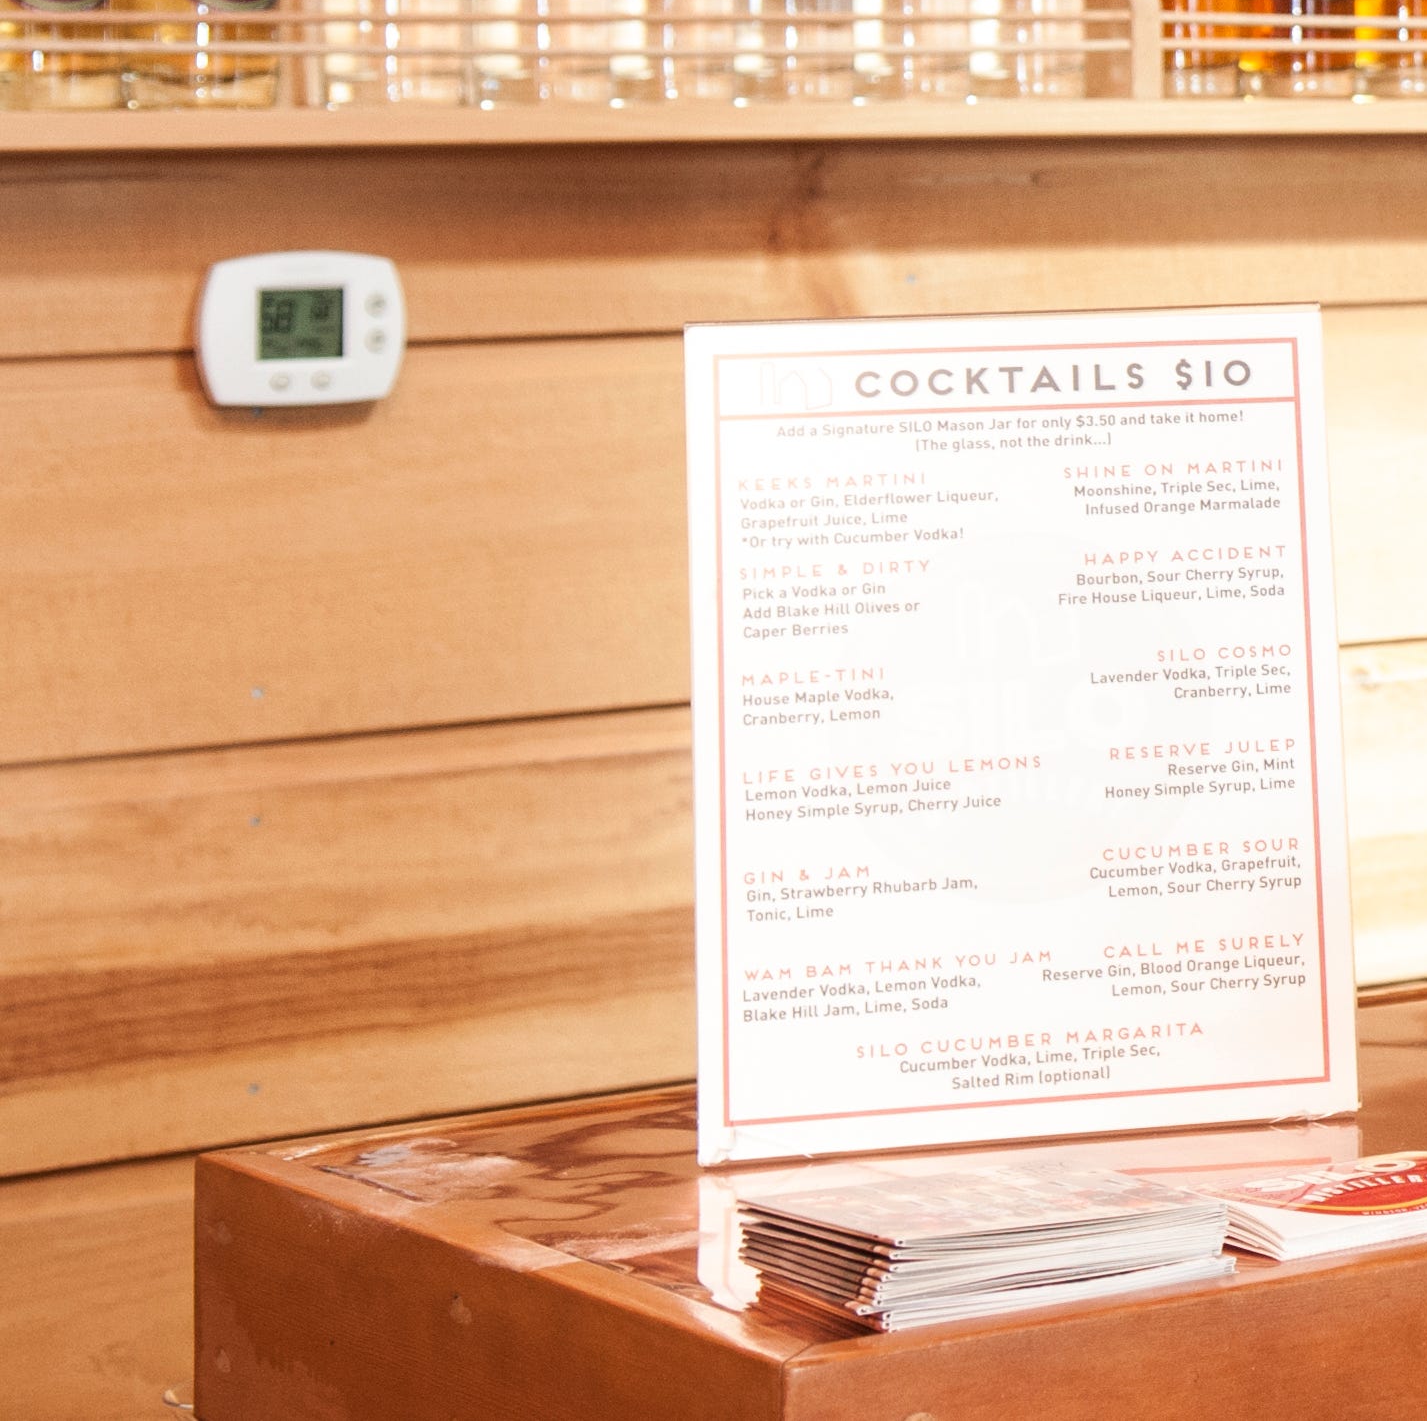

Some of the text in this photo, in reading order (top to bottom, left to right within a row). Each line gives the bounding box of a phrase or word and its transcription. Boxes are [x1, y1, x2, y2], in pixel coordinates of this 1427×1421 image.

[855, 358, 1251, 398] COCKTAILS $10
[777, 410, 1243, 438] Add a Signature SILO Mason Jar for only $3.50 and take it home!
[1063, 459, 1281, 479] SHINE ON MARTINI
[1074, 479, 1280, 497] Moonshine, Triple Sec, Lime,
[1085, 497, 1280, 515] Infused Orange Marmalade
[1084, 545, 1285, 566] HAPPY ACCIDENT
[1076, 567, 1284, 586] Bourbon, Sour Cherry Syrup,
[1058, 584, 1285, 605] Fire House Liqueur, Lime, Soda
[1157, 644, 1291, 662] SILO COSMO
[742, 667, 884, 687] MAPLE-TINI
[743, 688, 894, 706] House Maple Vodka,
[1174, 683, 1291, 699] Cranberry, Lime
[743, 709, 880, 726] Cranberry, Lemon
[1109, 738, 1295, 760] RESERVE JULEP
[742, 755, 1041, 785] LIFE GIVES YOU LEMONS
[1168, 758, 1294, 776] Reserve Gin, Mint
[745, 779, 951, 802] Lemon Vodka, Lemon Juice
[1105, 778, 1295, 799] Honey Simple Syrup, Lime
[746, 795, 1001, 822] Honey Simple Syrup, Cherry Juice
[1102, 837, 1298, 862] CUCUMBER SOUR
[744, 866, 869, 885] GIN & JAM
[1090, 855, 1301, 879] Cucumber Vodka, Grapefruit,
[746, 877, 978, 903] Gin, Strawberry Rhubarb Jam,
[1103, 933, 1303, 959] CALL ME SURELY
[744, 951, 1051, 981] WAM BAM THANK YOU JAM
[1042, 955, 1305, 981] Reserve Gin, Blood Orange Liqueur,
[743, 975, 981, 1002] Lavender Vodka, Lemon Vodka,
[1112, 974, 1306, 997] Lemon, Sour Cherry Syrup
[856, 1022, 1203, 1059] SILO CUCUMBER MARGARITA
[900, 1044, 1160, 1073] Cucumber Vodka, Lime, Triple Sec,
[952, 1074, 1000, 1090] Salted
[1005, 1073, 1034, 1086] Rim
